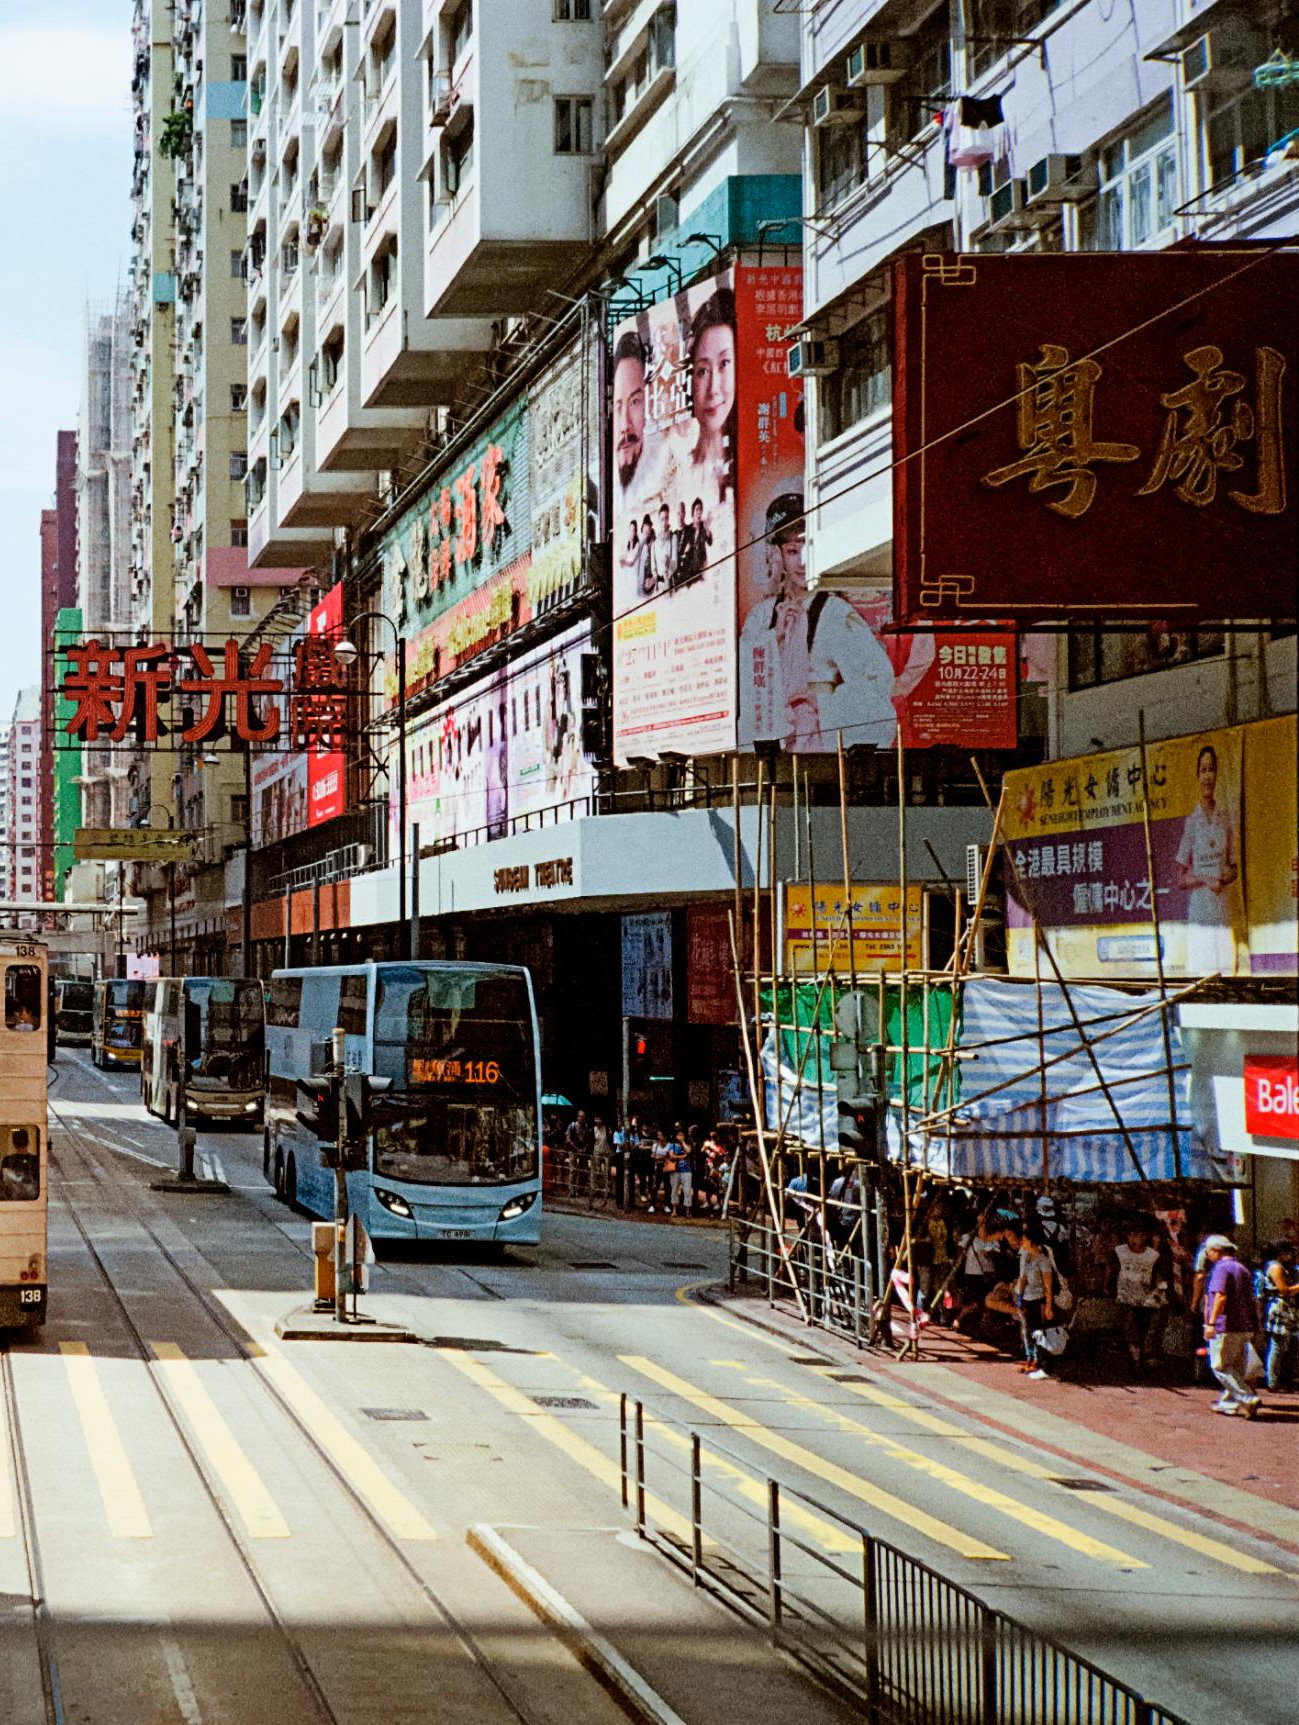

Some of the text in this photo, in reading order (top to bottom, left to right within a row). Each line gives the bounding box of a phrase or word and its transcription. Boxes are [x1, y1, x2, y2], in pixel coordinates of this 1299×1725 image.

[981, 343, 1288, 519] 粵劇
[64, 639, 283, 743] 新光
[534, 857, 573, 888] THEATRE
[1016, 841, 1103, 879] 全港最具規模
[16, 945, 36, 957] 138
[465, 1061, 499, 1083] 116
[20, 1290, 41, 1303] 138
